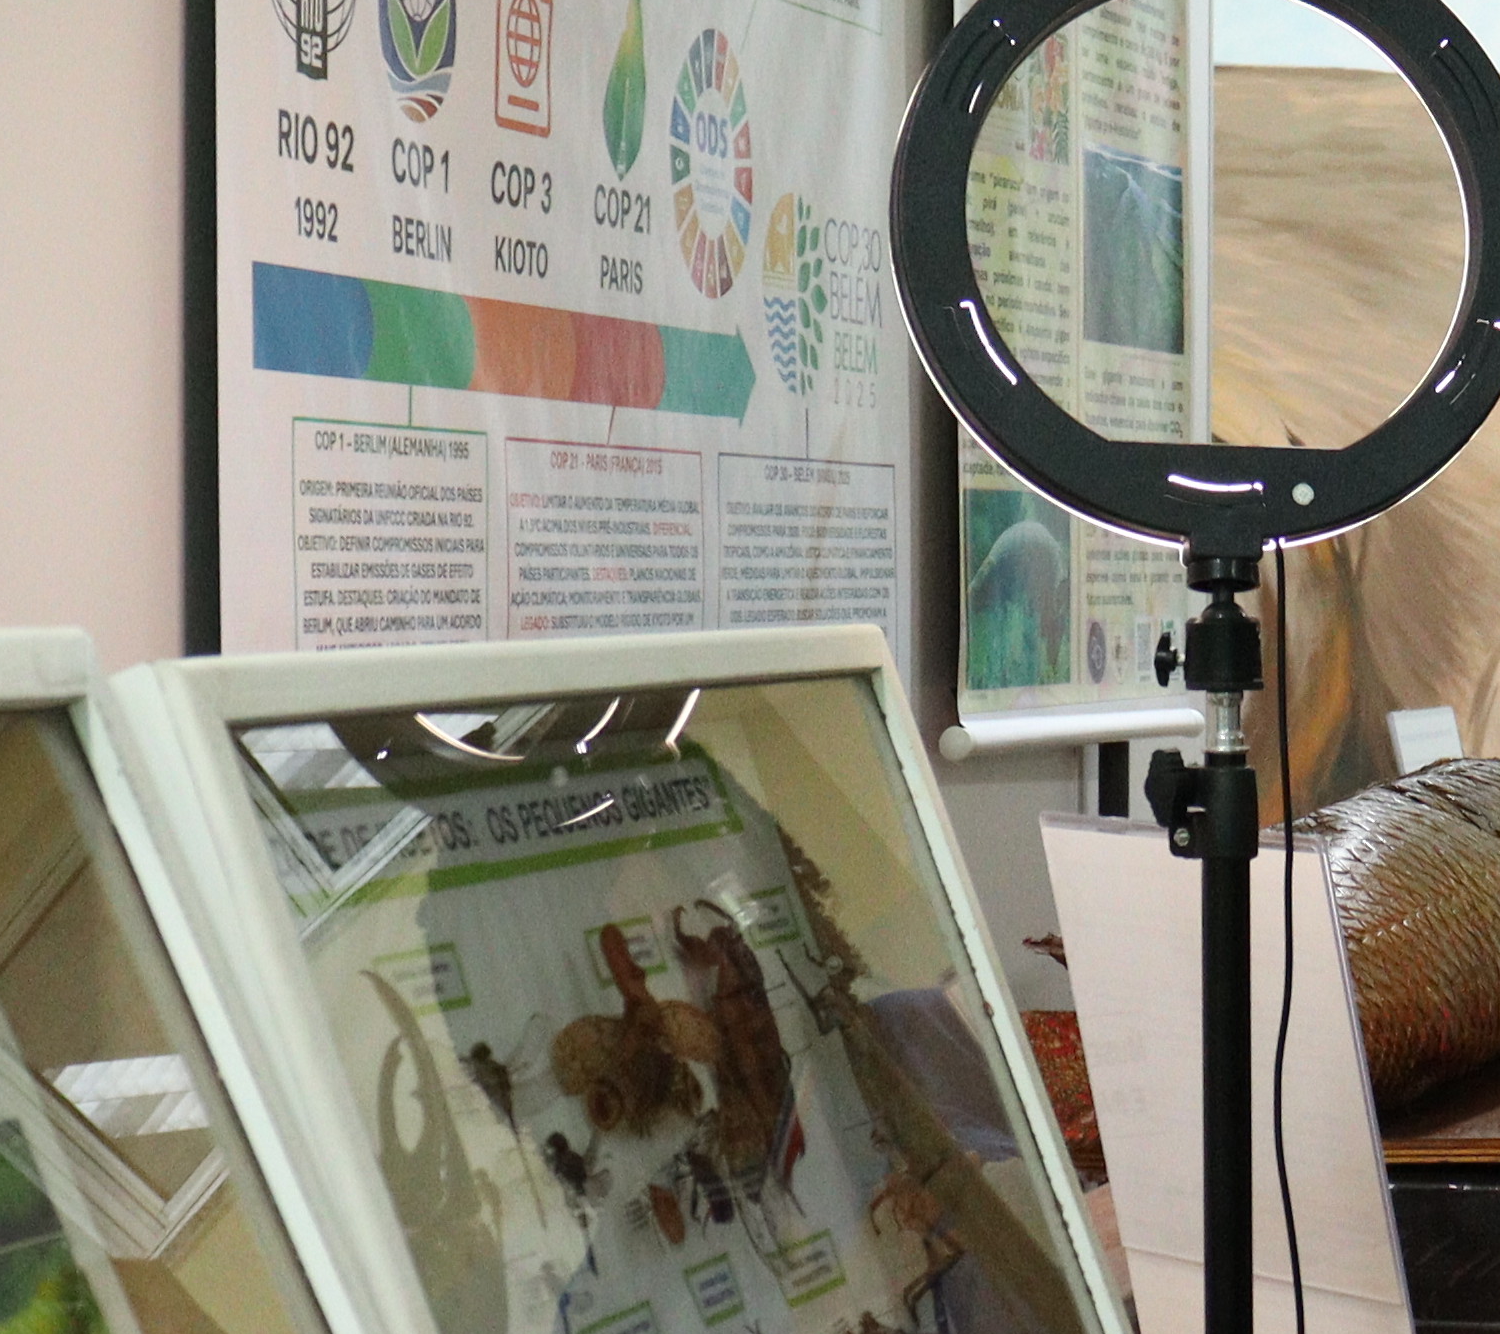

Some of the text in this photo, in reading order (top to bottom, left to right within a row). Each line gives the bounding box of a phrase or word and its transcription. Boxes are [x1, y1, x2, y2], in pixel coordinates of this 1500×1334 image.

[299, 36, 324, 68] 92
[278, 110, 354, 172] RIO 92
[696, 111, 728, 159] ODS
[392, 137, 449, 194] COP 1
[491, 161, 553, 215] COP 3
[295, 197, 338, 242] 1992
[594, 184, 650, 235] COP 21
[392, 215, 452, 262] BERLIN
[495, 236, 548, 278] KIOTO
[600, 255, 643, 295] PARIS
[316, 429, 469, 462] COP 1 BERLIM (ALEMANHA) 1995
[487, 805, 518, 845] OS
[519, 791, 623, 843] PEQUENOS
